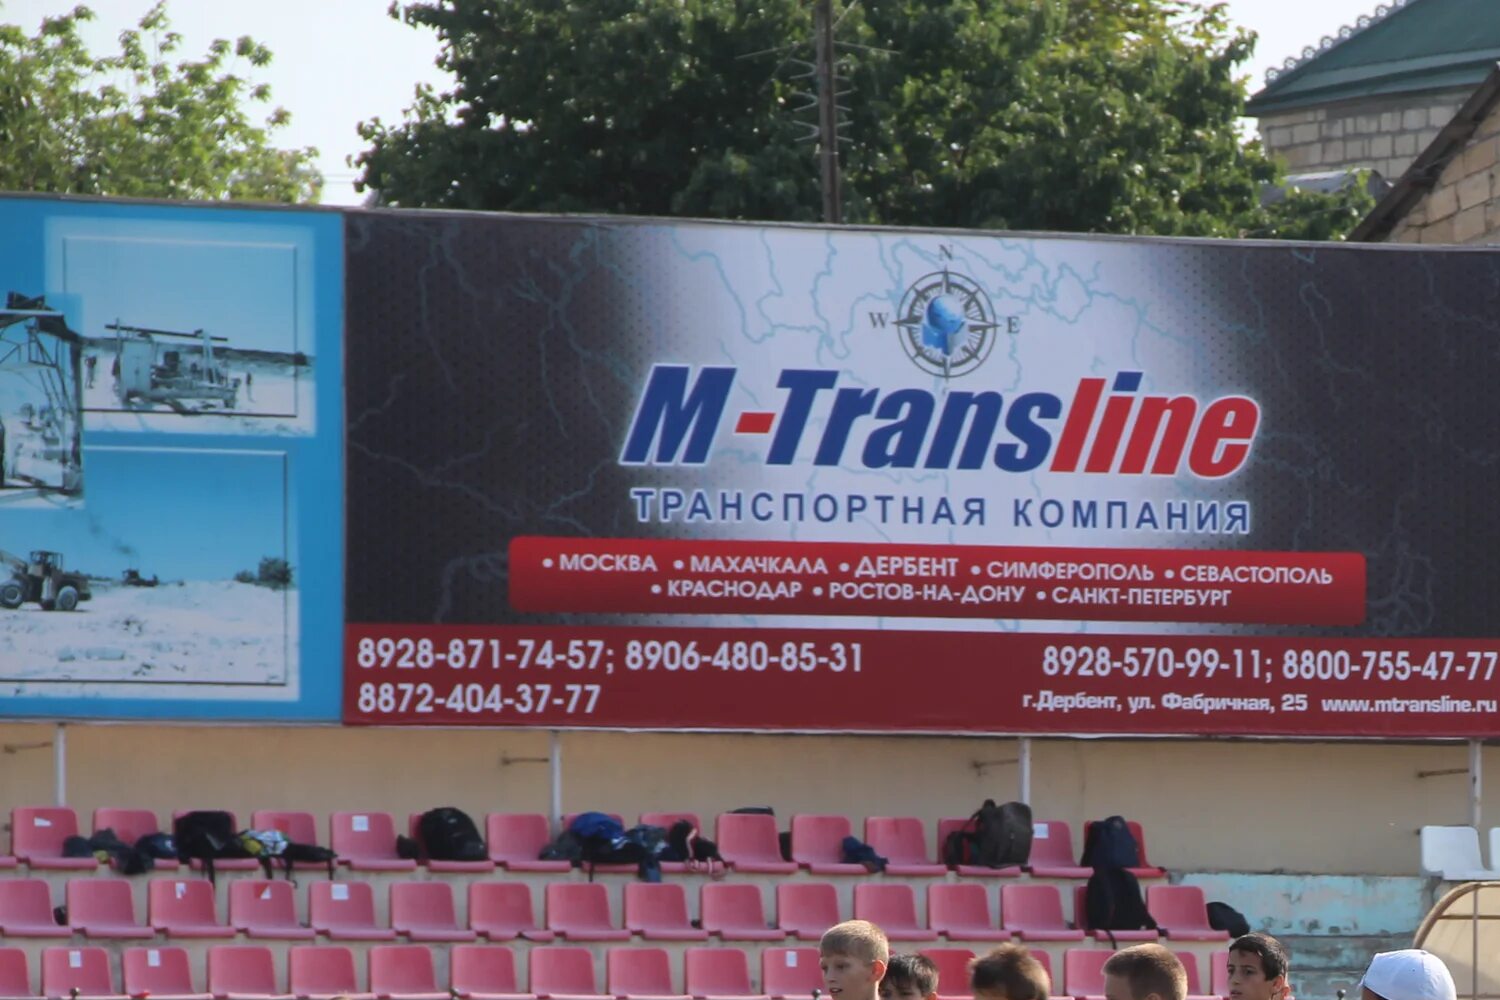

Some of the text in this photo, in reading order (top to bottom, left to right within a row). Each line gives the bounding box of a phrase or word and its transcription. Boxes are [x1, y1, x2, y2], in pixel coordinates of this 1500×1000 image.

[939, 244, 954, 261] N
[869, 312, 889, 328] W
[1007, 316, 1020, 334] E
[620, 366, 1261, 479] M-Transline
[632, 490, 1250, 533] ТРАНСПОРТНАЯ КОМПАНИЯ
[559, 553, 1333, 584] МОСКВА МАХАЧКАЛА ДЕРБЕНТ СИМФЕРОПОЛЬ СЕВАСТОПОЛЬ
[667, 579, 1232, 607] КРАСНОДАР РОСТОВ-НА-ДОНУ САНКТ-ПЕТЕРБУРГ
[357, 637, 863, 673] 8928-871-74-57; 8906-480-85-31
[1042, 645, 1498, 684] 8928-570-99-11; 8800-755-47-77
[357, 683, 601, 714] 8872-404-37-77
[1023, 691, 1308, 714] г.Дербент, ул. Фабричная, 25
[1321, 694, 1498, 713] www.mtransline.ru
